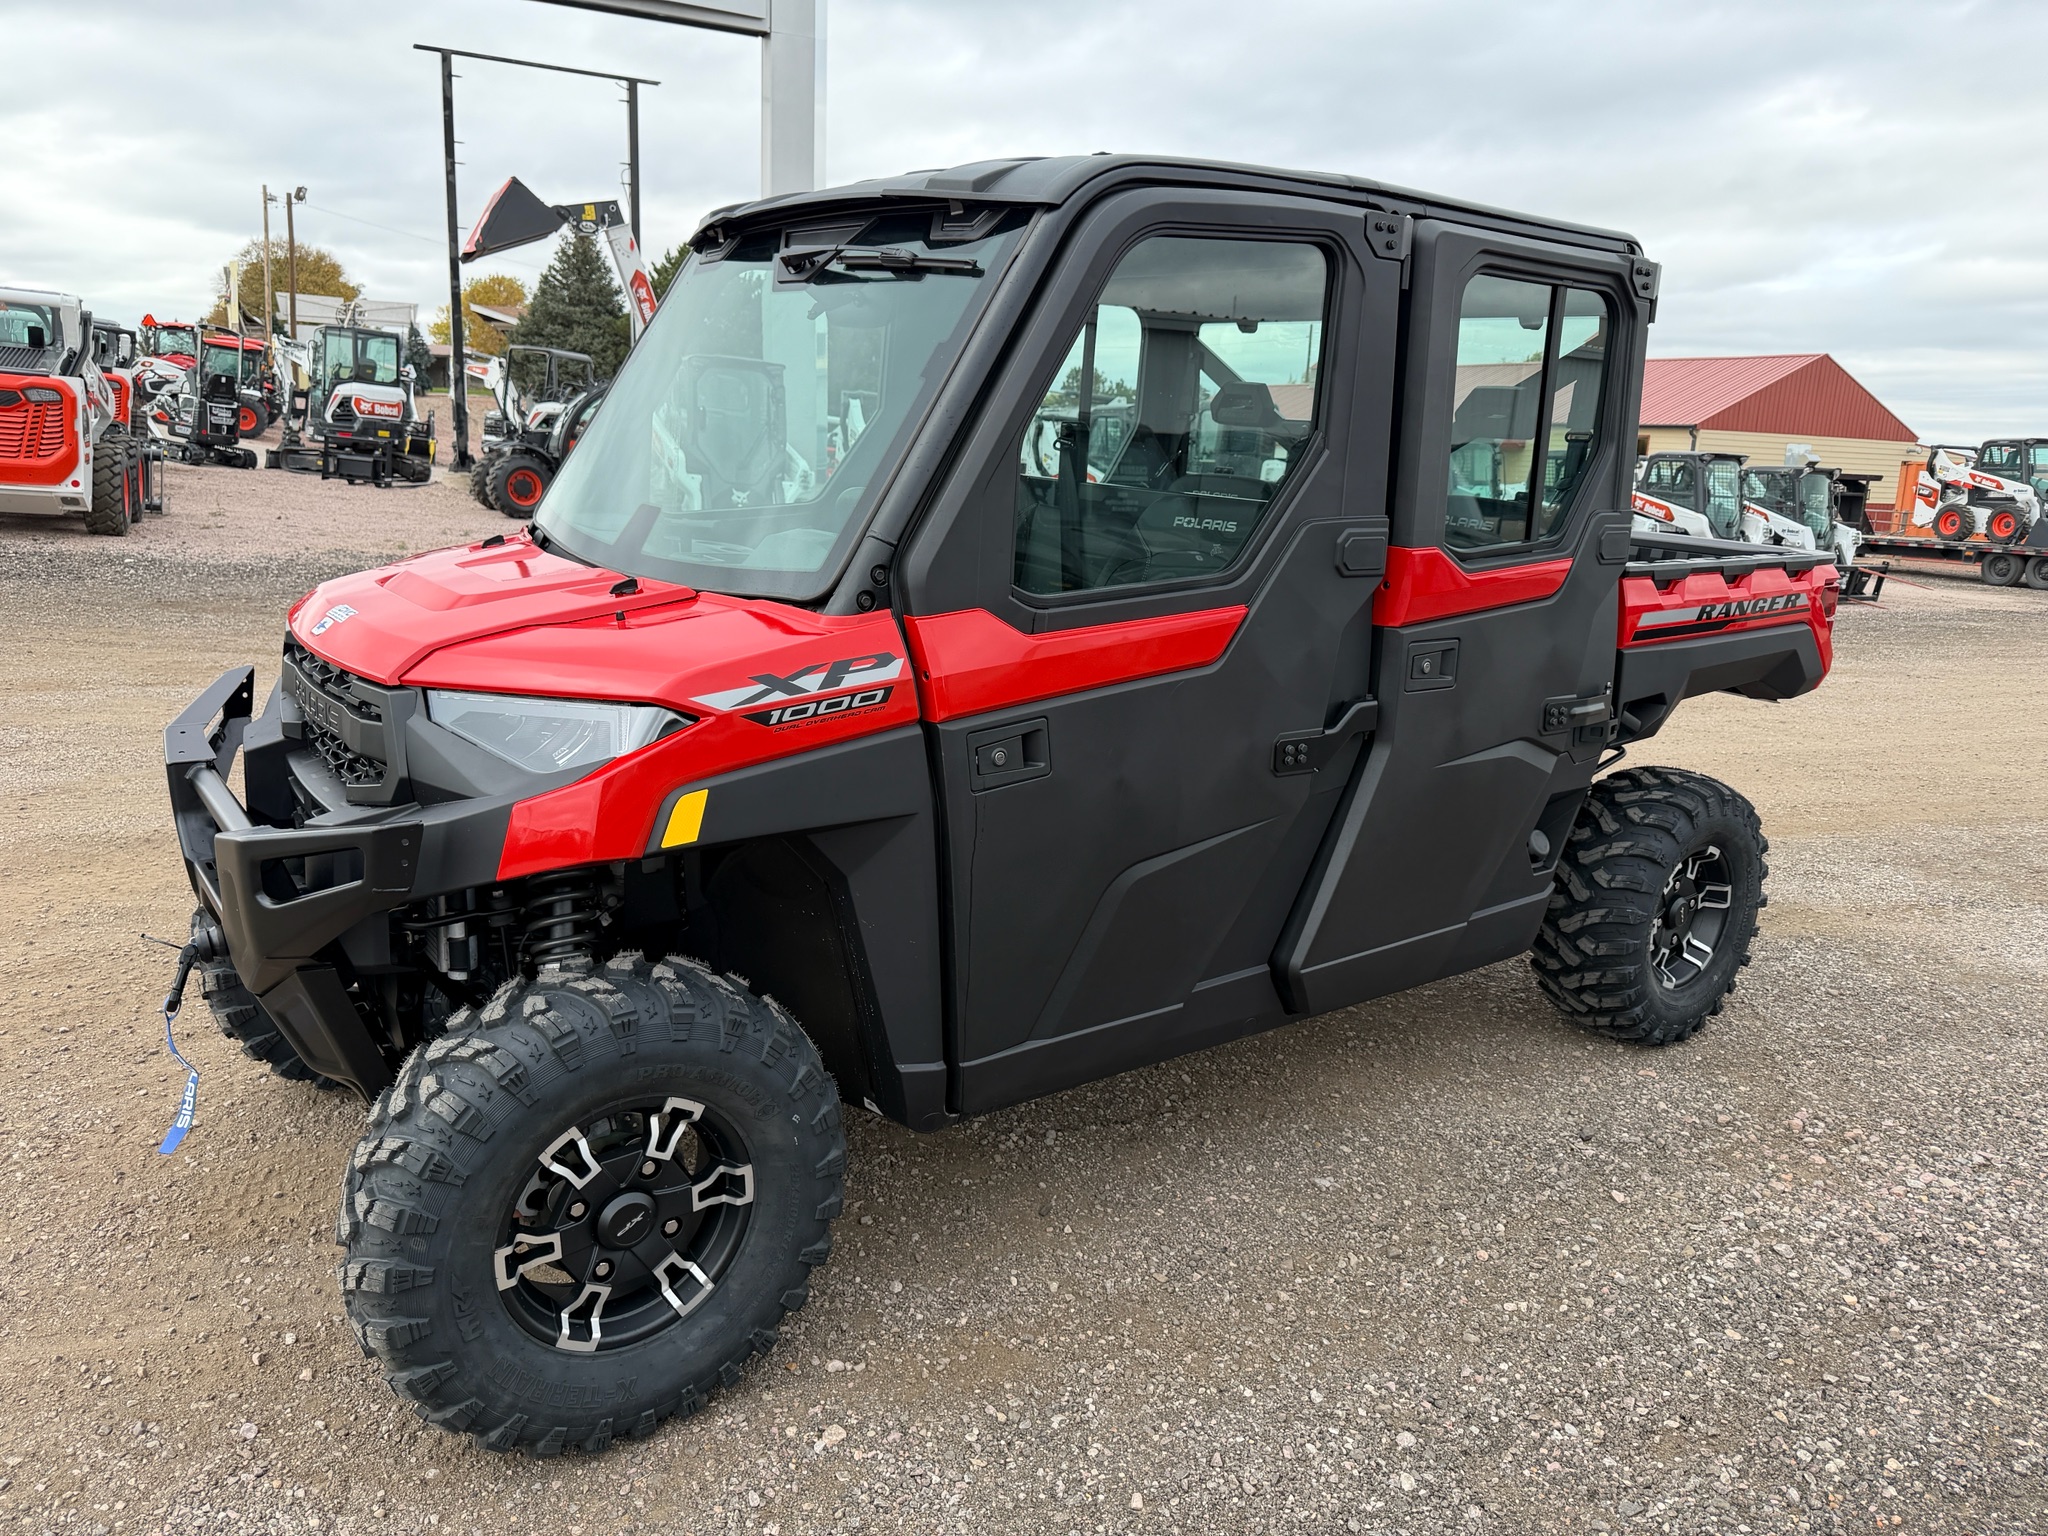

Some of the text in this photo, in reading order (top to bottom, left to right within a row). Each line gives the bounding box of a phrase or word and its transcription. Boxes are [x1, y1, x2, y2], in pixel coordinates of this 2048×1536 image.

[374, 403, 399, 416] Bobcat
[1173, 516, 1238, 533] POLARIS
[1695, 592, 1802, 623] RANGER
[729, 652, 899, 708] XP
[768, 689, 886, 726] 1000
[773, 705, 887, 733] DUAL OVERHEAD CAM
[485, 1354, 639, 1409] X-TERRAIN
